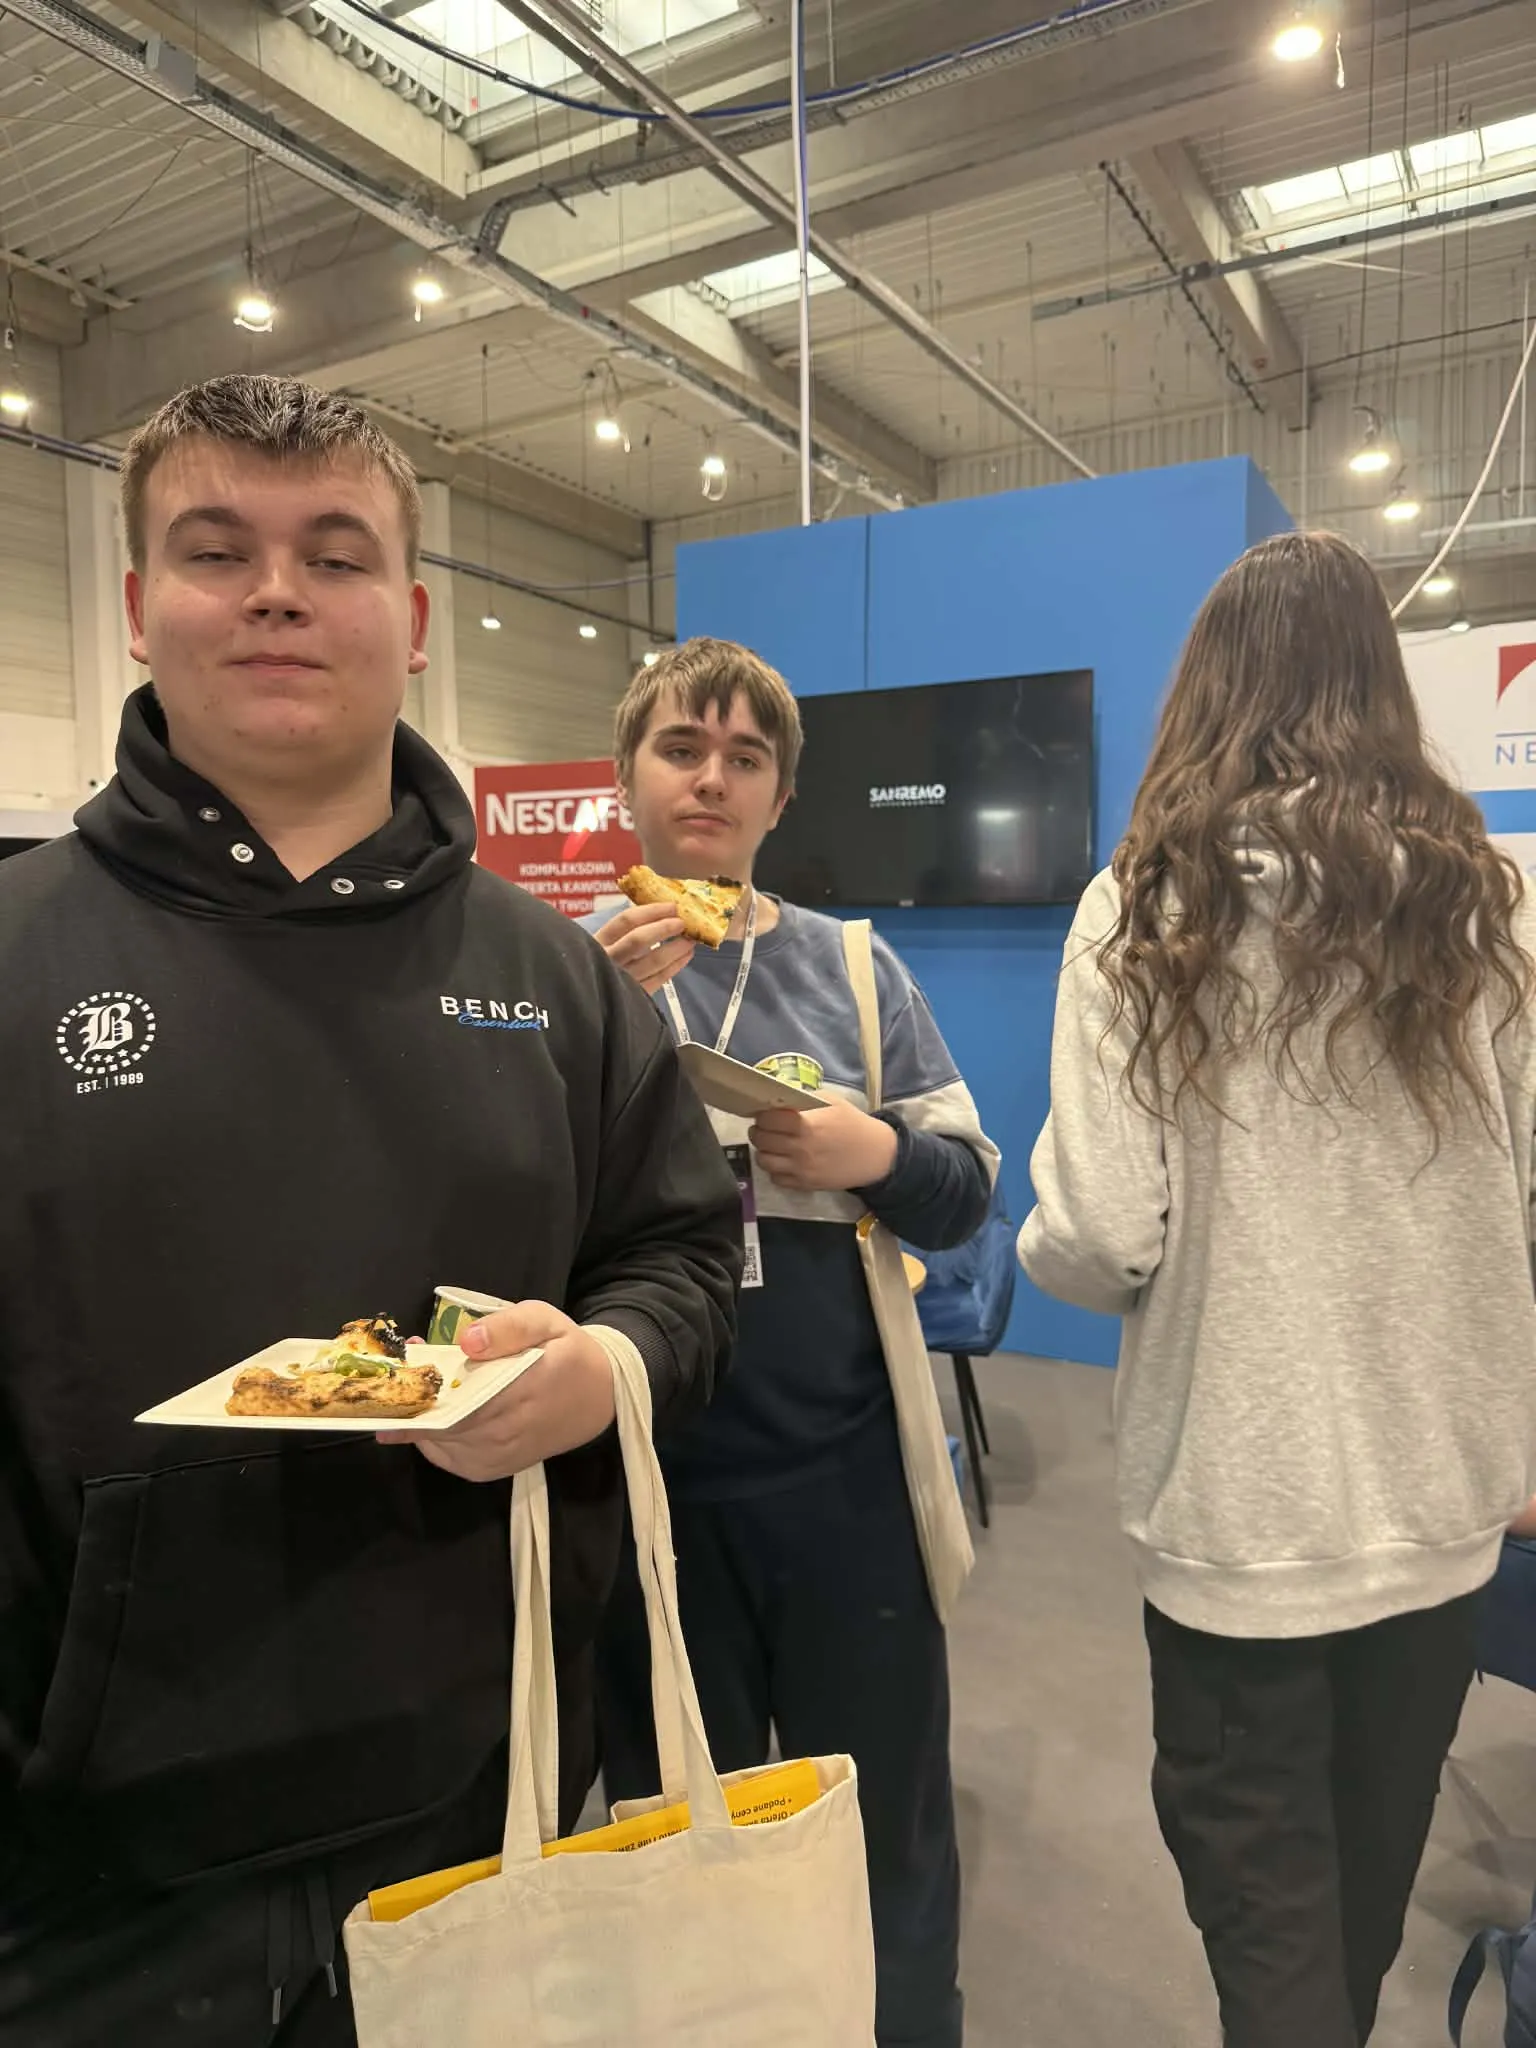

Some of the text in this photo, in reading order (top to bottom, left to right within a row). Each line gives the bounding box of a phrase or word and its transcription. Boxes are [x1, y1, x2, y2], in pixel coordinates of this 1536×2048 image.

[869, 784, 946, 801] SANREMO
[520, 861, 616, 876] KOMPLEKSOWA
[440, 995, 549, 1029] BENCH
[76, 1072, 144, 1094] EST. 1989
